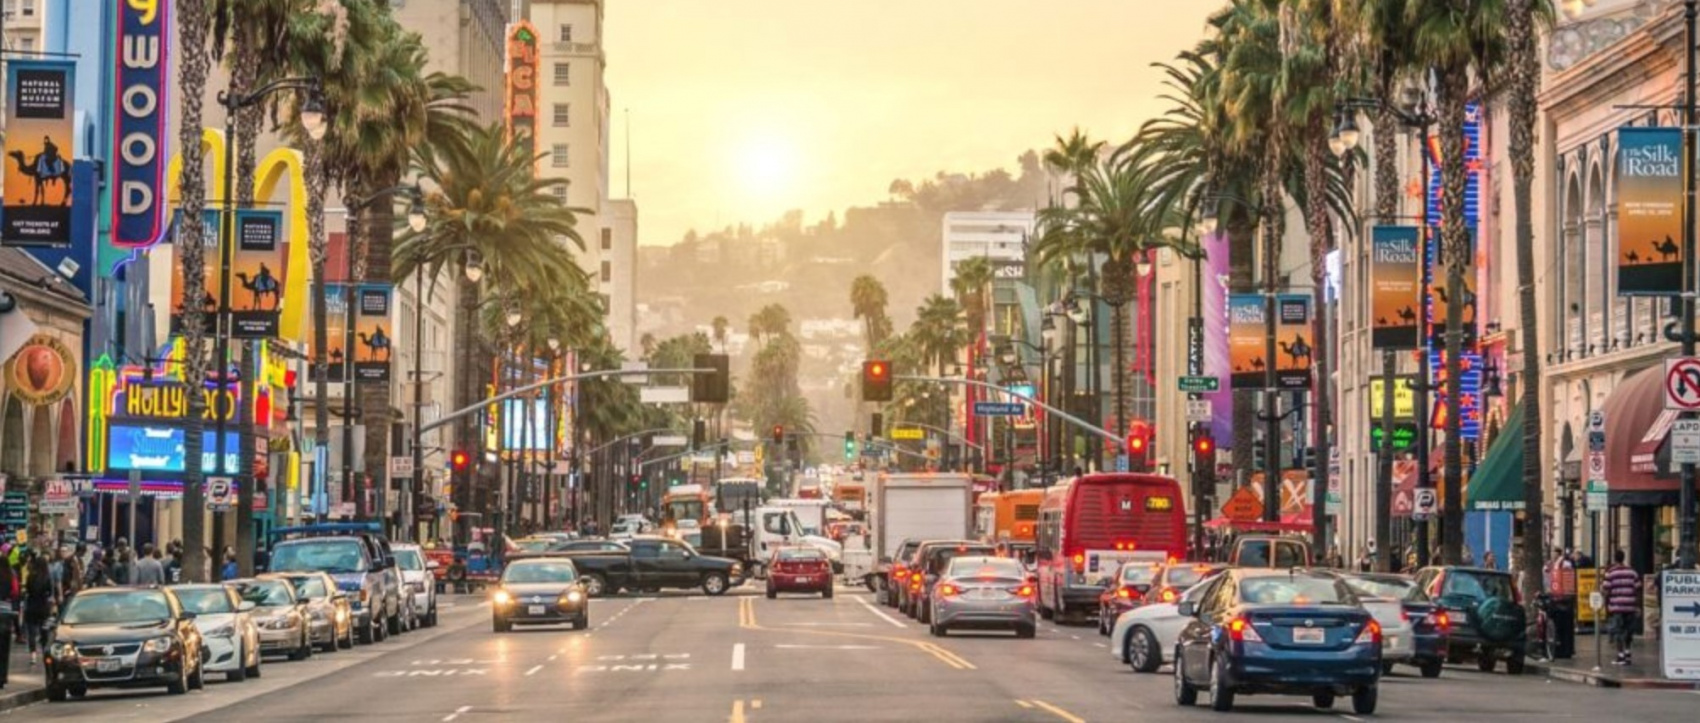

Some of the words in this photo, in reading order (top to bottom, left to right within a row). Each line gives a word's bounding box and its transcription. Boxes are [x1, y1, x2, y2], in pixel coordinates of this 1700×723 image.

[1642, 144, 1673, 162] Silk
[1629, 156, 1679, 176] Road
[1390, 239, 1410, 252] Silk
[1380, 249, 1416, 263] Road
[977, 405, 1009, 413] Highland
[1672, 422, 1700, 431] LAPD
